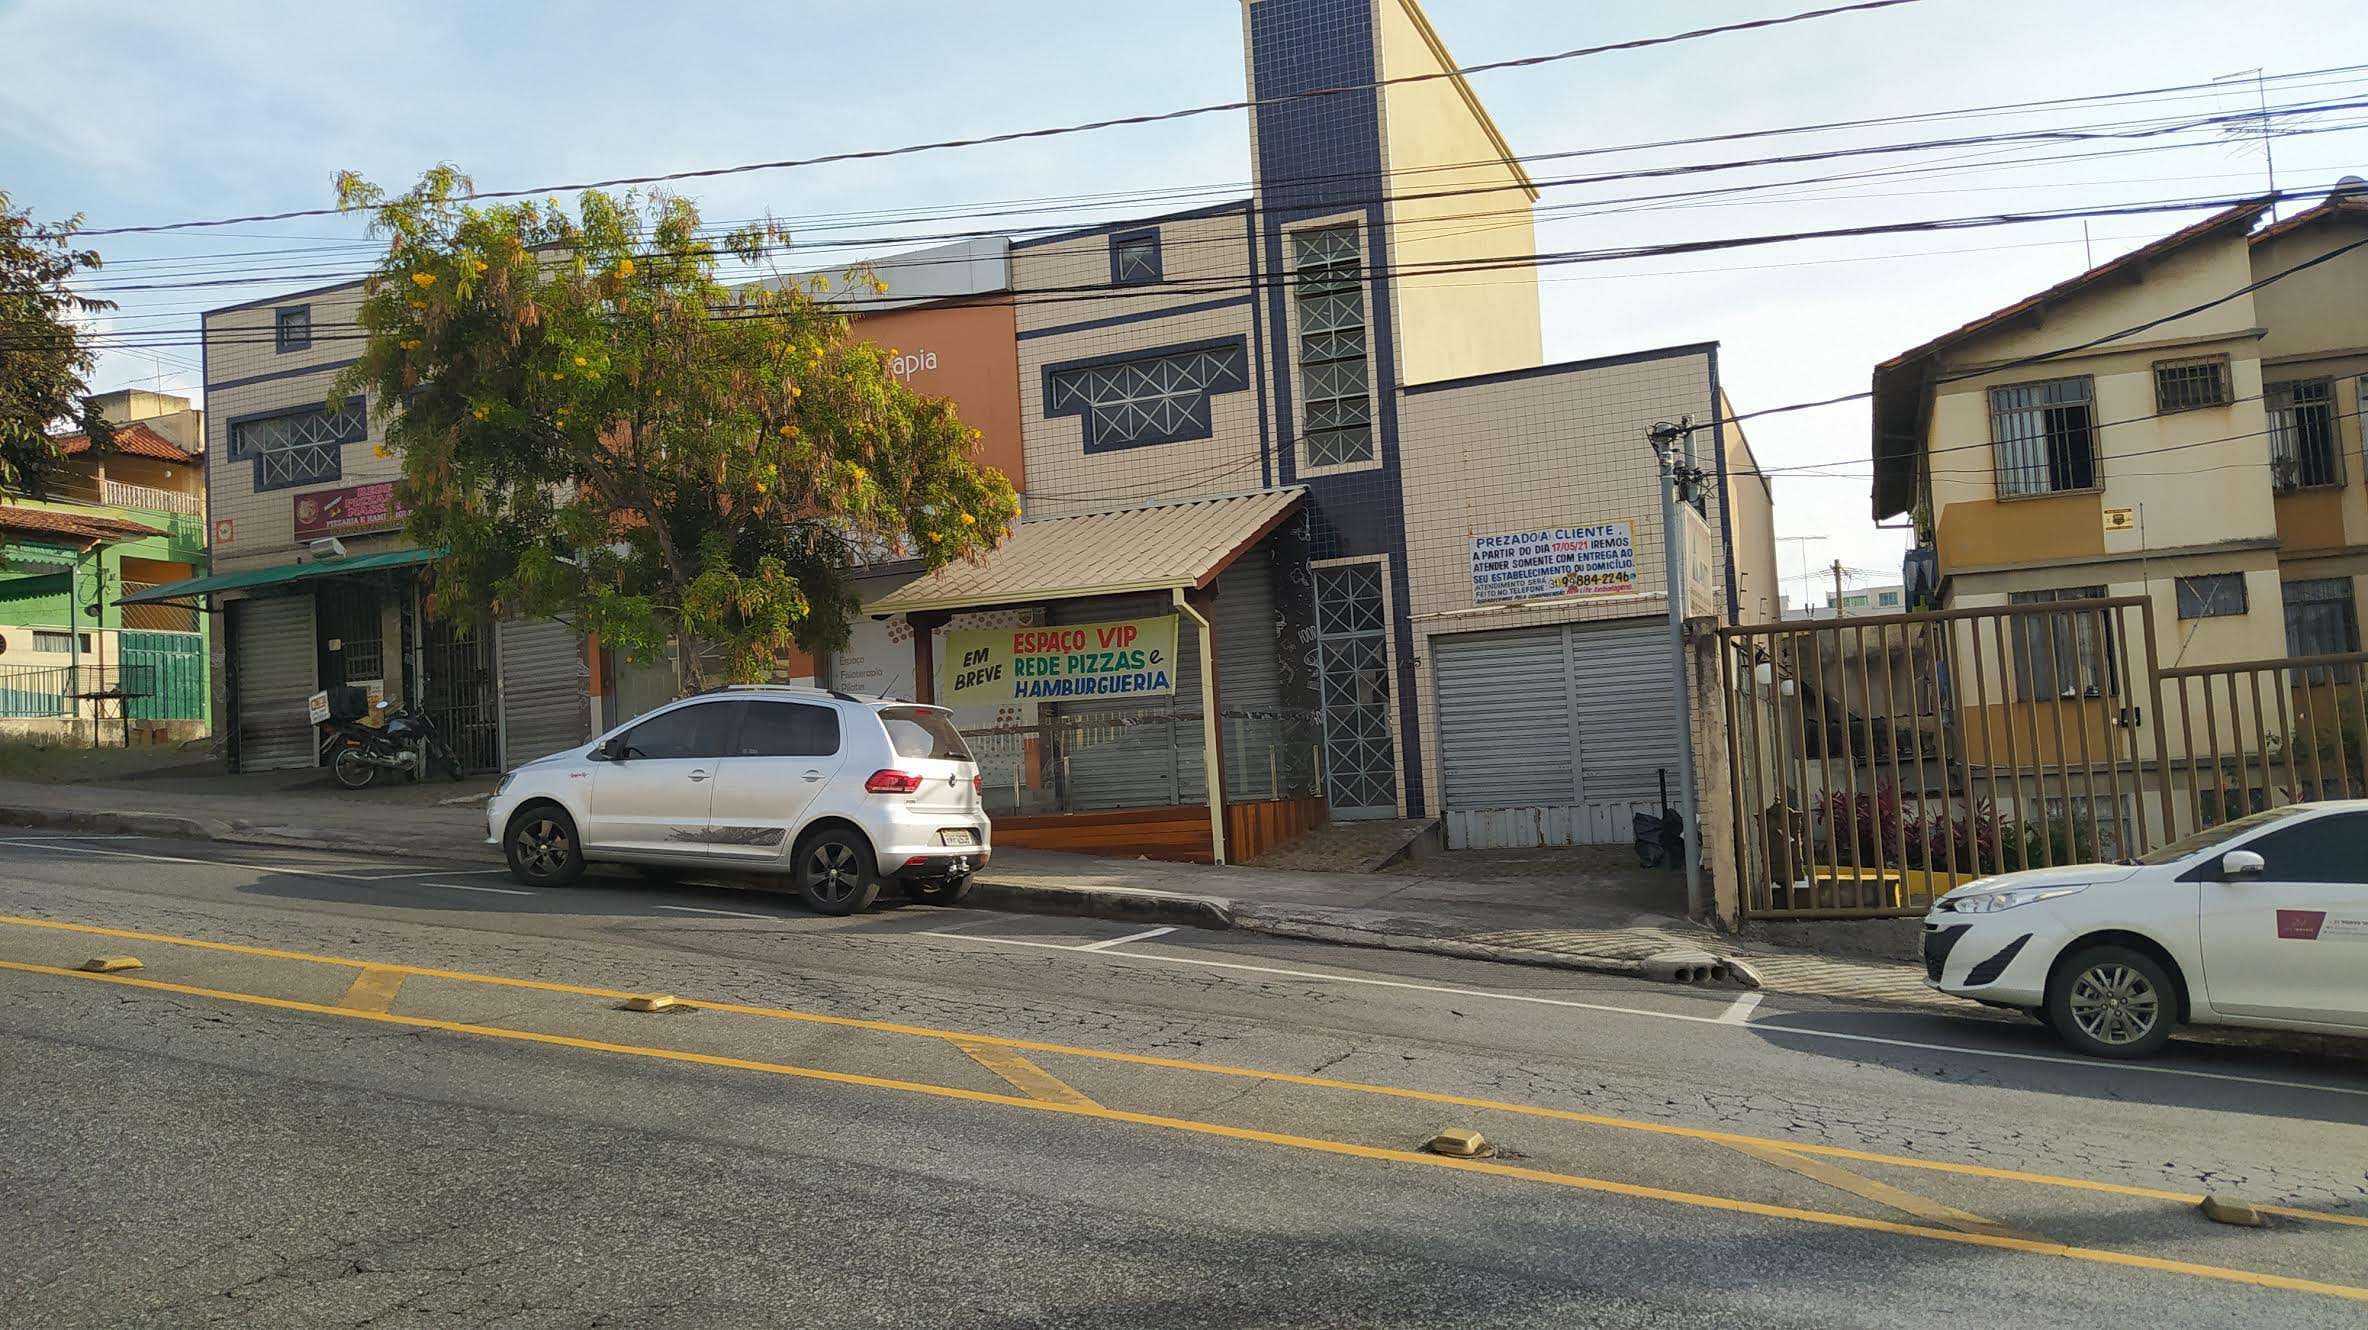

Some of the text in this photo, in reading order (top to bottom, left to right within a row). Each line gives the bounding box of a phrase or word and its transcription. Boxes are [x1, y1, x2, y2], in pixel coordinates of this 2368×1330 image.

[1473, 537, 1629, 561] A PARTIR DO DIA 17/05/21 IREMOS
[1473, 548, 1633, 573] ATENDER SOMENTE COM ENTREGA AO
[1473, 575, 1488, 584] SEU
[1492, 565, 1572, 583] ESTABELECIMENTO
[1574, 564, 1584, 573] OU
[1475, 580, 1525, 591] ATENDIMENTO
[1013, 625, 1137, 655] ESPAÇO VIP
[963, 647, 990, 668] EM
[1014, 649, 1164, 677] REDE PIZZAS e
[954, 663, 1002, 691] BREVE
[1014, 670, 1170, 698] HAMBURGUERIA
